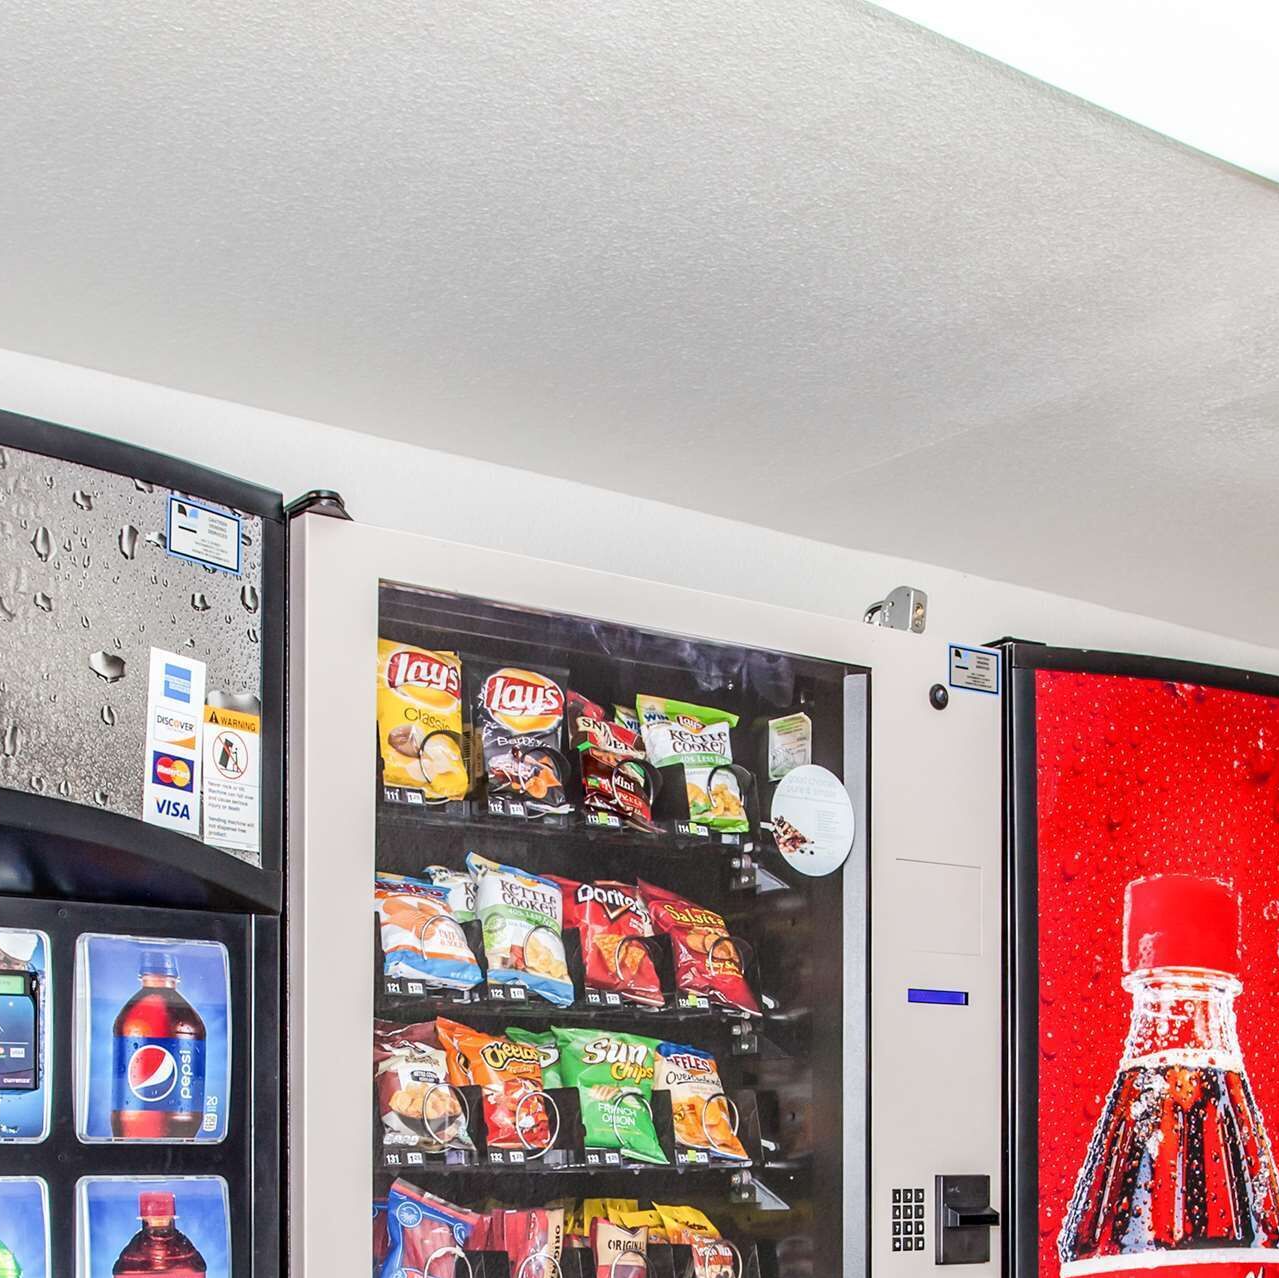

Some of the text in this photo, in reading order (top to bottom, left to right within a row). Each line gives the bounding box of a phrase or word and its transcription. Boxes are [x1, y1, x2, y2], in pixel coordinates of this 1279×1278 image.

[156, 713, 194, 732] DISCOVER
[220, 716, 257, 732] WARNING
[386, 790, 400, 800] 111
[154, 797, 191, 821] VISA
[489, 803, 503, 812] 112
[387, 982, 400, 992] 121
[490, 988, 504, 998] 122
[588, 994, 600, 1002] 123
[582, 1037, 648, 1067] Sun
[179, 1049, 194, 1099] pepsi
[610, 1061, 655, 1085] Chips
[206, 1095, 218, 1106] 20
[386, 1153, 400, 1164] 131
[490, 1153, 503, 1163] 132
[587, 1154, 599, 1163] 133
